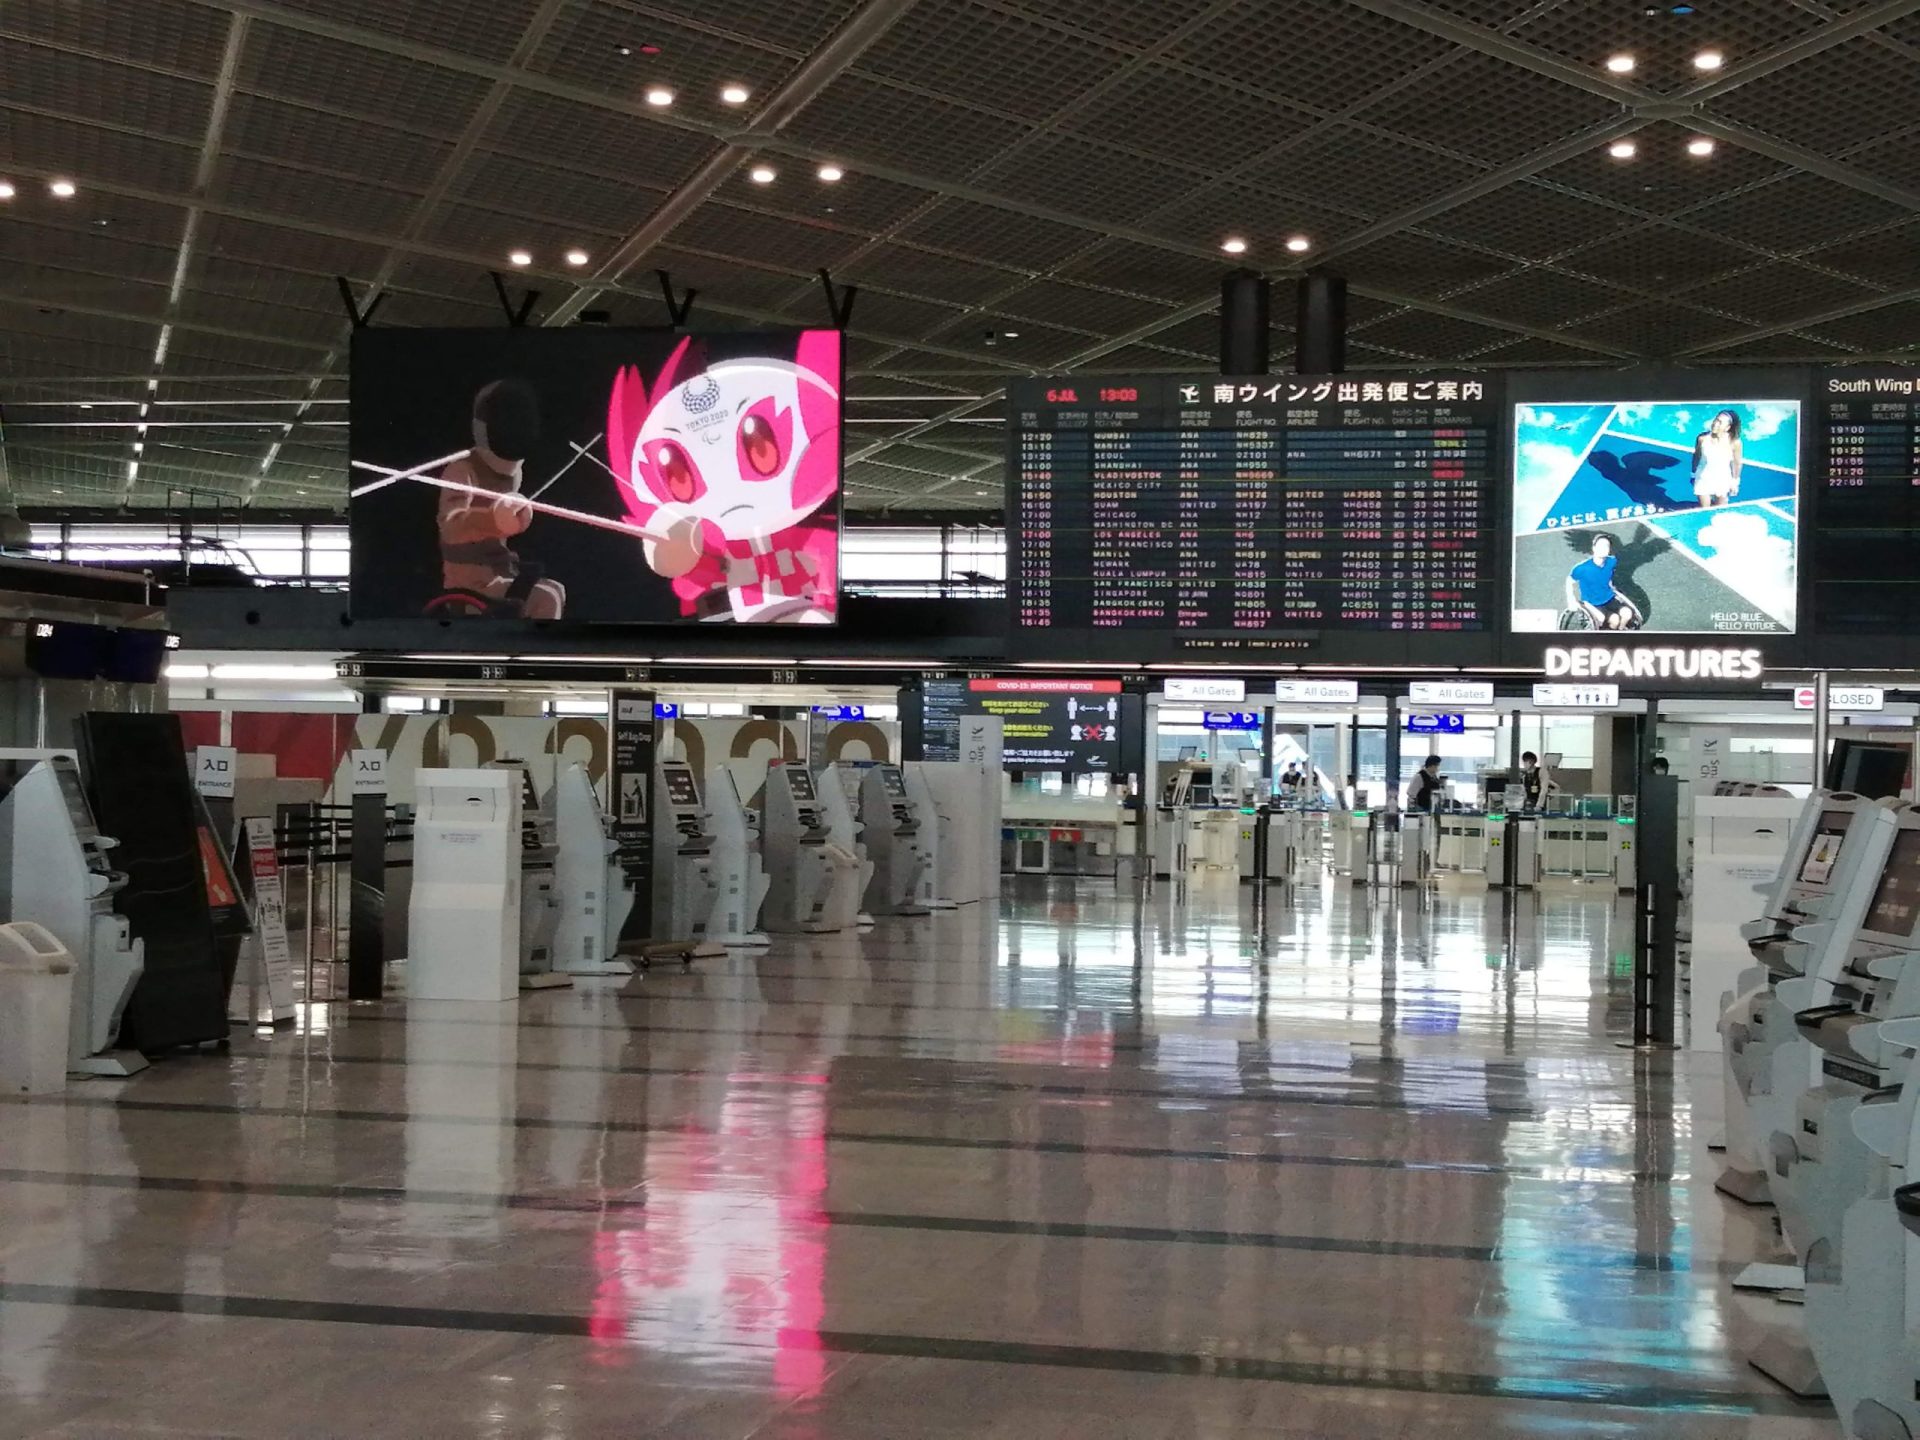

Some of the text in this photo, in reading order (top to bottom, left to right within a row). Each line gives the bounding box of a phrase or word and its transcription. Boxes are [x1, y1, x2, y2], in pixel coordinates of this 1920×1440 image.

[1828, 378, 1871, 393] South
[1874, 378, 1913, 395] Wing
[1213, 381, 1484, 404] 南ウイング出発便ご案内
[686, 409, 729, 430] TOKYO 2020
[1830, 426, 1864, 434] 19:00
[1022, 433, 1052, 441] 12:20
[1180, 431, 1199, 439] ANA
[1829, 436, 1864, 444] 19:00
[1021, 442, 1051, 450] 13:10
[1180, 441, 1199, 449] ANA
[1829, 446, 1864, 455] 19:25
[1021, 452, 1051, 460] 13:20
[1094, 452, 1124, 460] SEOUL
[1180, 451, 1217, 459] ASIANA
[1286, 451, 1305, 459] ANA
[1021, 461, 1198, 470] 14:00 SHANGHAI ANA
[1094, 471, 1161, 479] VLADIVOSTOK
[1180, 471, 1198, 479] ANA
[1829, 468, 1864, 476] 21:20
[1021, 480, 1478, 490] 16:40 MEXICO CITY ANA ON TIME
[1094, 491, 1136, 499] HOUSTON
[1180, 491, 1198, 499] ANA
[1286, 491, 1323, 499] UNITED
[1432, 490, 1445, 498] ON
[1453, 490, 1478, 498] TIME
[1021, 501, 1051, 509] 16:50
[1180, 501, 1216, 509] UNITED
[1286, 501, 1304, 509] ANA
[1432, 500, 1445, 508] ON
[1452, 500, 1478, 508] TIME
[1021, 511, 1051, 519] 17:00
[1093, 511, 1136, 519] CHICAGO
[1180, 511, 1198, 519] ANA
[1285, 511, 1323, 519] UNITED
[1432, 511, 1445, 519] ON
[1452, 511, 1478, 519] TIME
[1021, 521, 1051, 529] 17:00
[1093, 520, 1154, 528] WASHINGTON
[1160, 520, 1172, 528] DC
[1180, 521, 1198, 529] ANA
[1285, 521, 1323, 529] UNITED
[1432, 521, 1445, 529] ON
[1452, 521, 1478, 529] TIME
[1021, 530, 1478, 539] 17:00 LOS ANGELES ANA UNITED ON TIME
[1021, 540, 1198, 548] 17:00 SAN FRANCISCO ANA
[1093, 550, 1130, 558] MANILA
[1179, 550, 1198, 558] ANA
[1431, 551, 1444, 559] ON
[1452, 551, 1477, 559] TIME
[1021, 560, 1050, 568] 17:15
[1093, 560, 1129, 568] NEWARK
[1179, 560, 1216, 568] UNITED
[1285, 561, 1303, 569] ANA
[1431, 561, 1444, 569] ON
[1452, 561, 1477, 569] TIME
[1021, 570, 1050, 578] 17:30
[1093, 570, 1123, 578] KUALA
[1129, 570, 1166, 578] LUMPUR
[1179, 570, 1197, 578] ANA
[1285, 571, 1322, 579] UNITED
[1431, 571, 1444, 579] ON
[1451, 571, 1477, 579] TIME
[1093, 579, 1111, 587] SAN
[1117, 579, 1172, 587] FRANCISCO
[1179, 580, 1216, 588] UNITED
[1285, 581, 1303, 589] ANA
[1431, 581, 1444, 589] ON
[1451, 581, 1477, 589] TIME
[1093, 589, 1303, 599] SINGAPORE ANA
[1179, 600, 1477, 609] ANA ON TIME
[1284, 611, 1476, 620] UNITED ON TIME
[1710, 612, 1738, 622] HELLO
[1092, 619, 1197, 628] HANOI ANA
[1714, 622, 1777, 631] HELLO FUTURE
[1544, 646, 1763, 678] DEPARTURES
[1030, 682, 1068, 690] IMPORTANT
[1069, 682, 1094, 691] NOTICE
[1191, 686, 1237, 697] All Gates
[1303, 687, 1350, 698] All Gates
[1438, 689, 1486, 699] All Gates
[1828, 694, 1874, 705] LOSED
[203, 758, 229, 772] 入口
[359, 760, 382, 772] 入口
[197, 780, 233, 789] ENTRANCE
[355, 779, 385, 787] ENTRANCE
